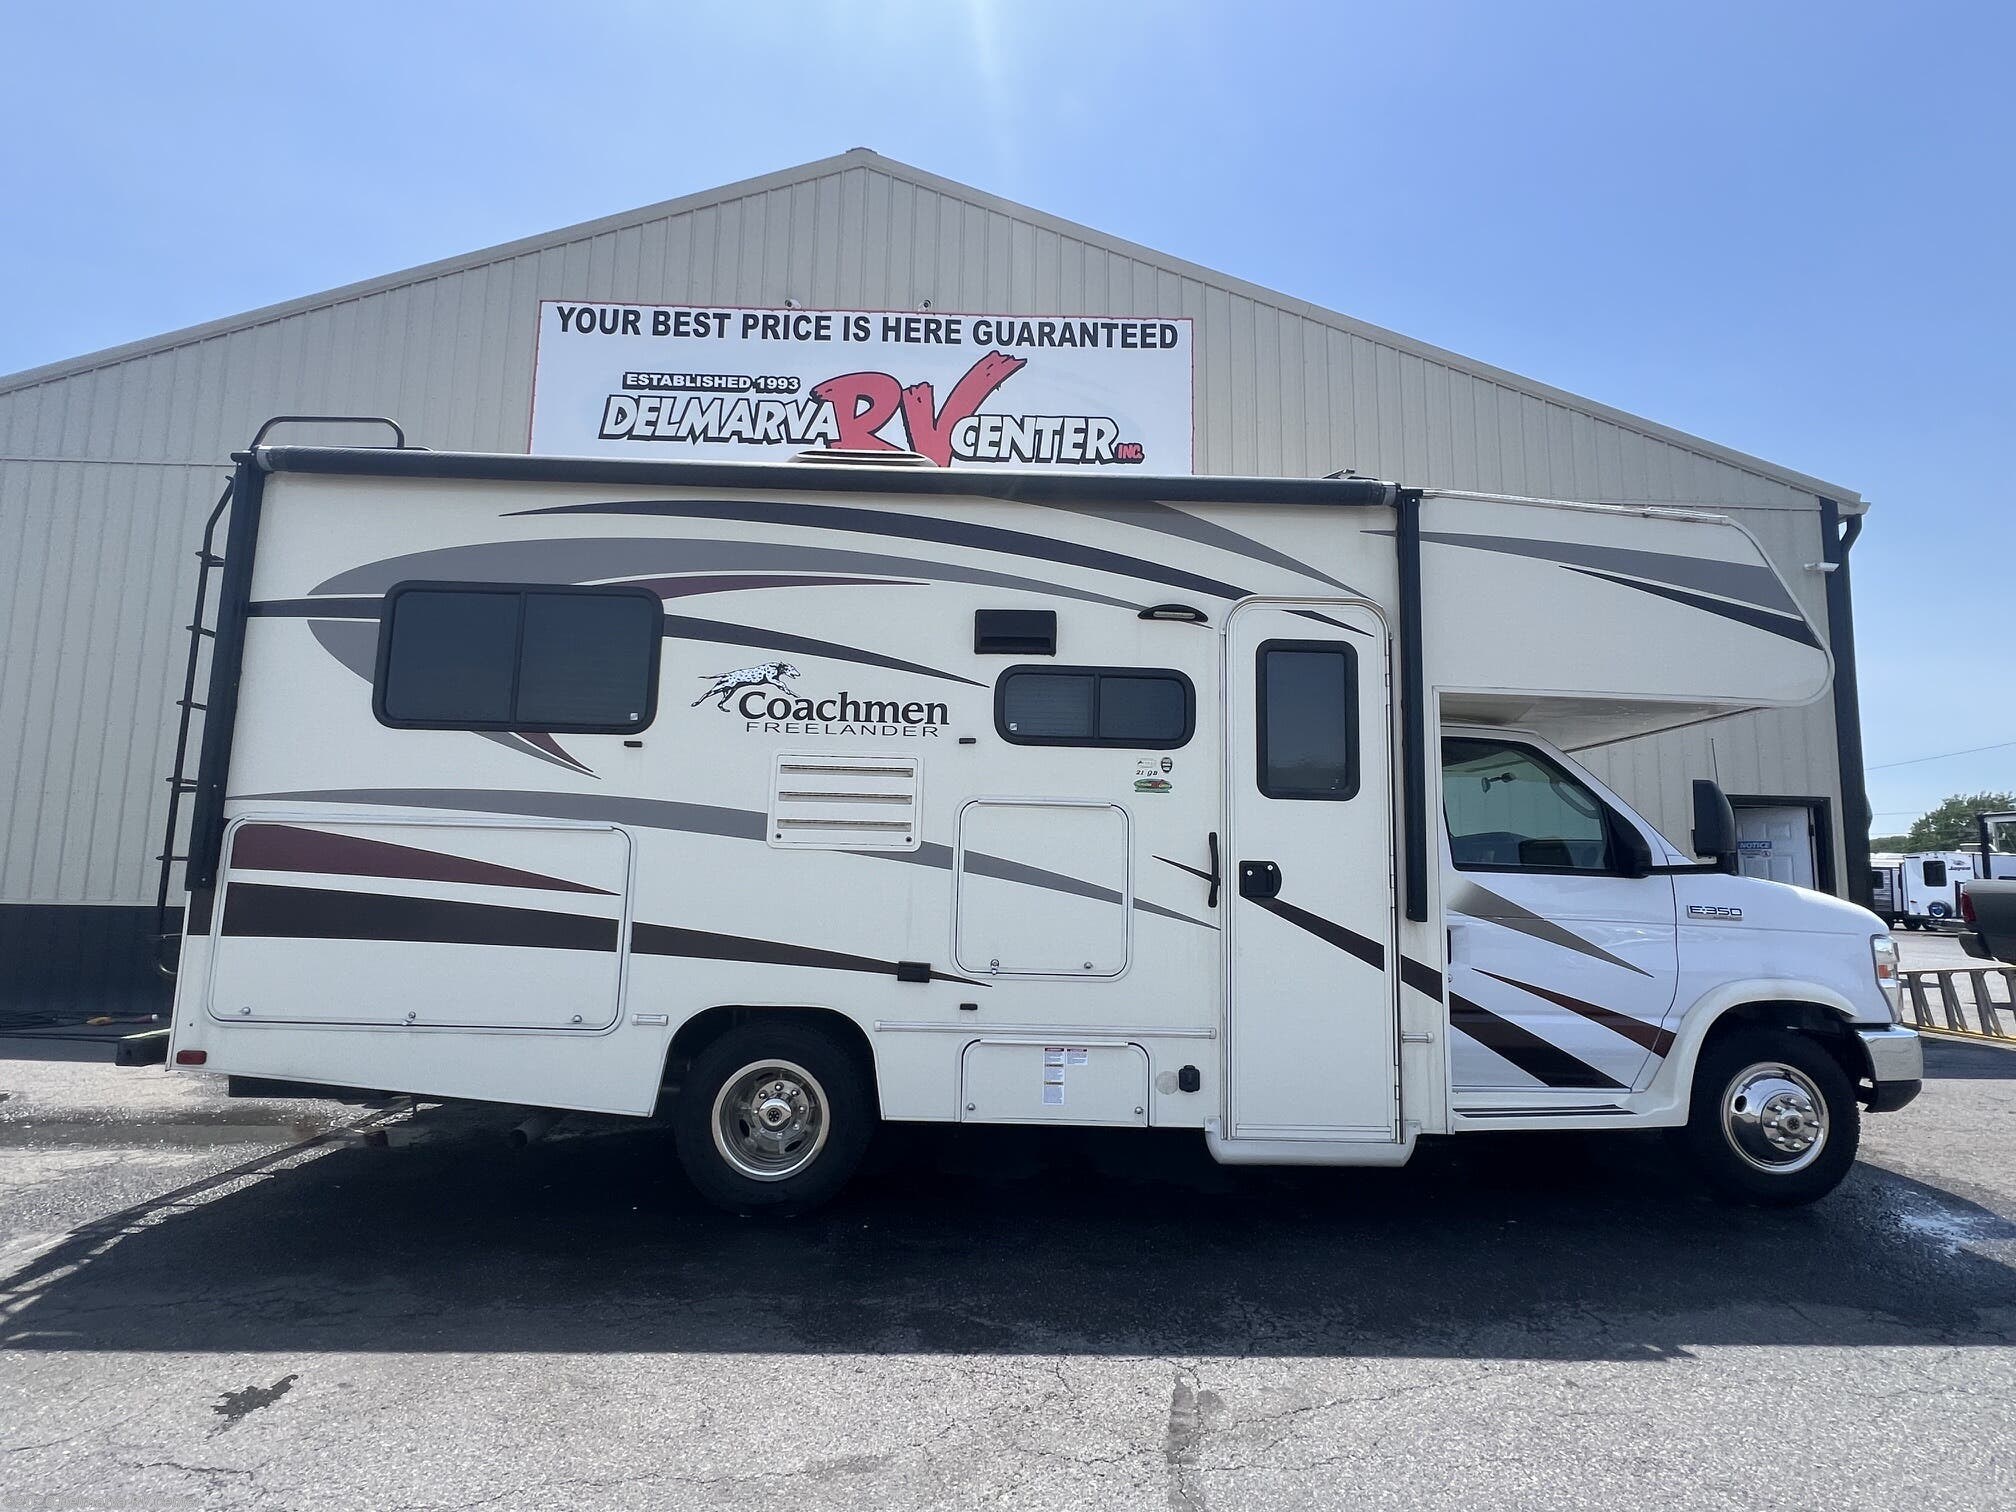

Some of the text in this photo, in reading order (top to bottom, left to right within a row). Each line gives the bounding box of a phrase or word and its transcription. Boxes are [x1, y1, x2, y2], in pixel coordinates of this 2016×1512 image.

[556, 306, 1179, 349] YOUR BEST PRICE IS HERE GUARANTEED
[624, 373, 800, 392] ESTABLISHED 1993
[599, 350, 1145, 467] DELMARVA RV CENTER INC.
[738, 691, 949, 726] Coachmen
[746, 721, 939, 738] FREELANDER
[1689, 905, 1743, 916] E-350
